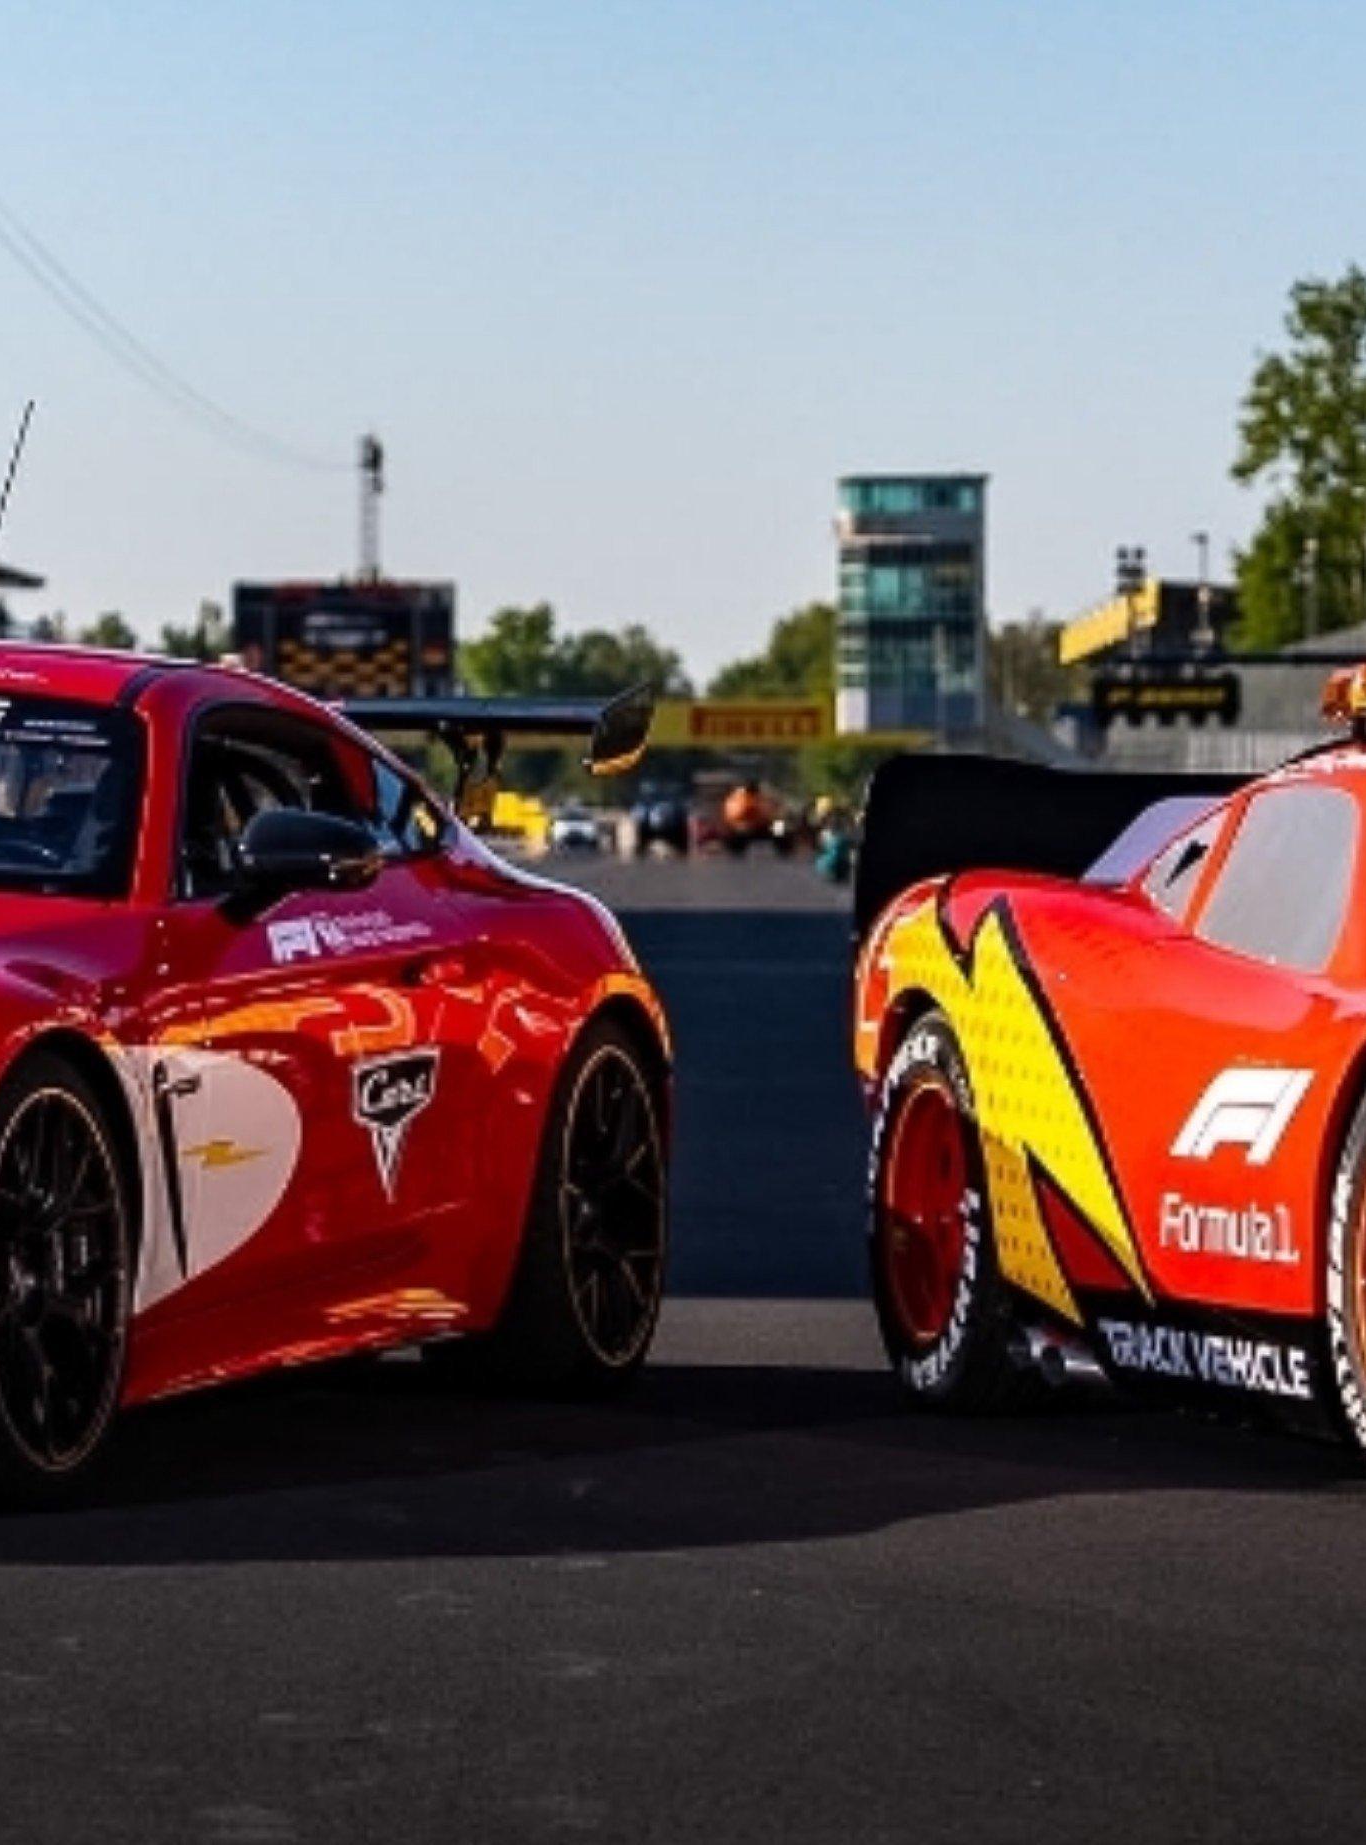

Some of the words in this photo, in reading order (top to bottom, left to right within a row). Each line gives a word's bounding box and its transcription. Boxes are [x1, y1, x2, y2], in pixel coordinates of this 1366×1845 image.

[361, 1069, 428, 1114] Cars
[1097, 1317, 1191, 1377] TRACK
[1186, 1331, 1312, 1399] VEHICLE
